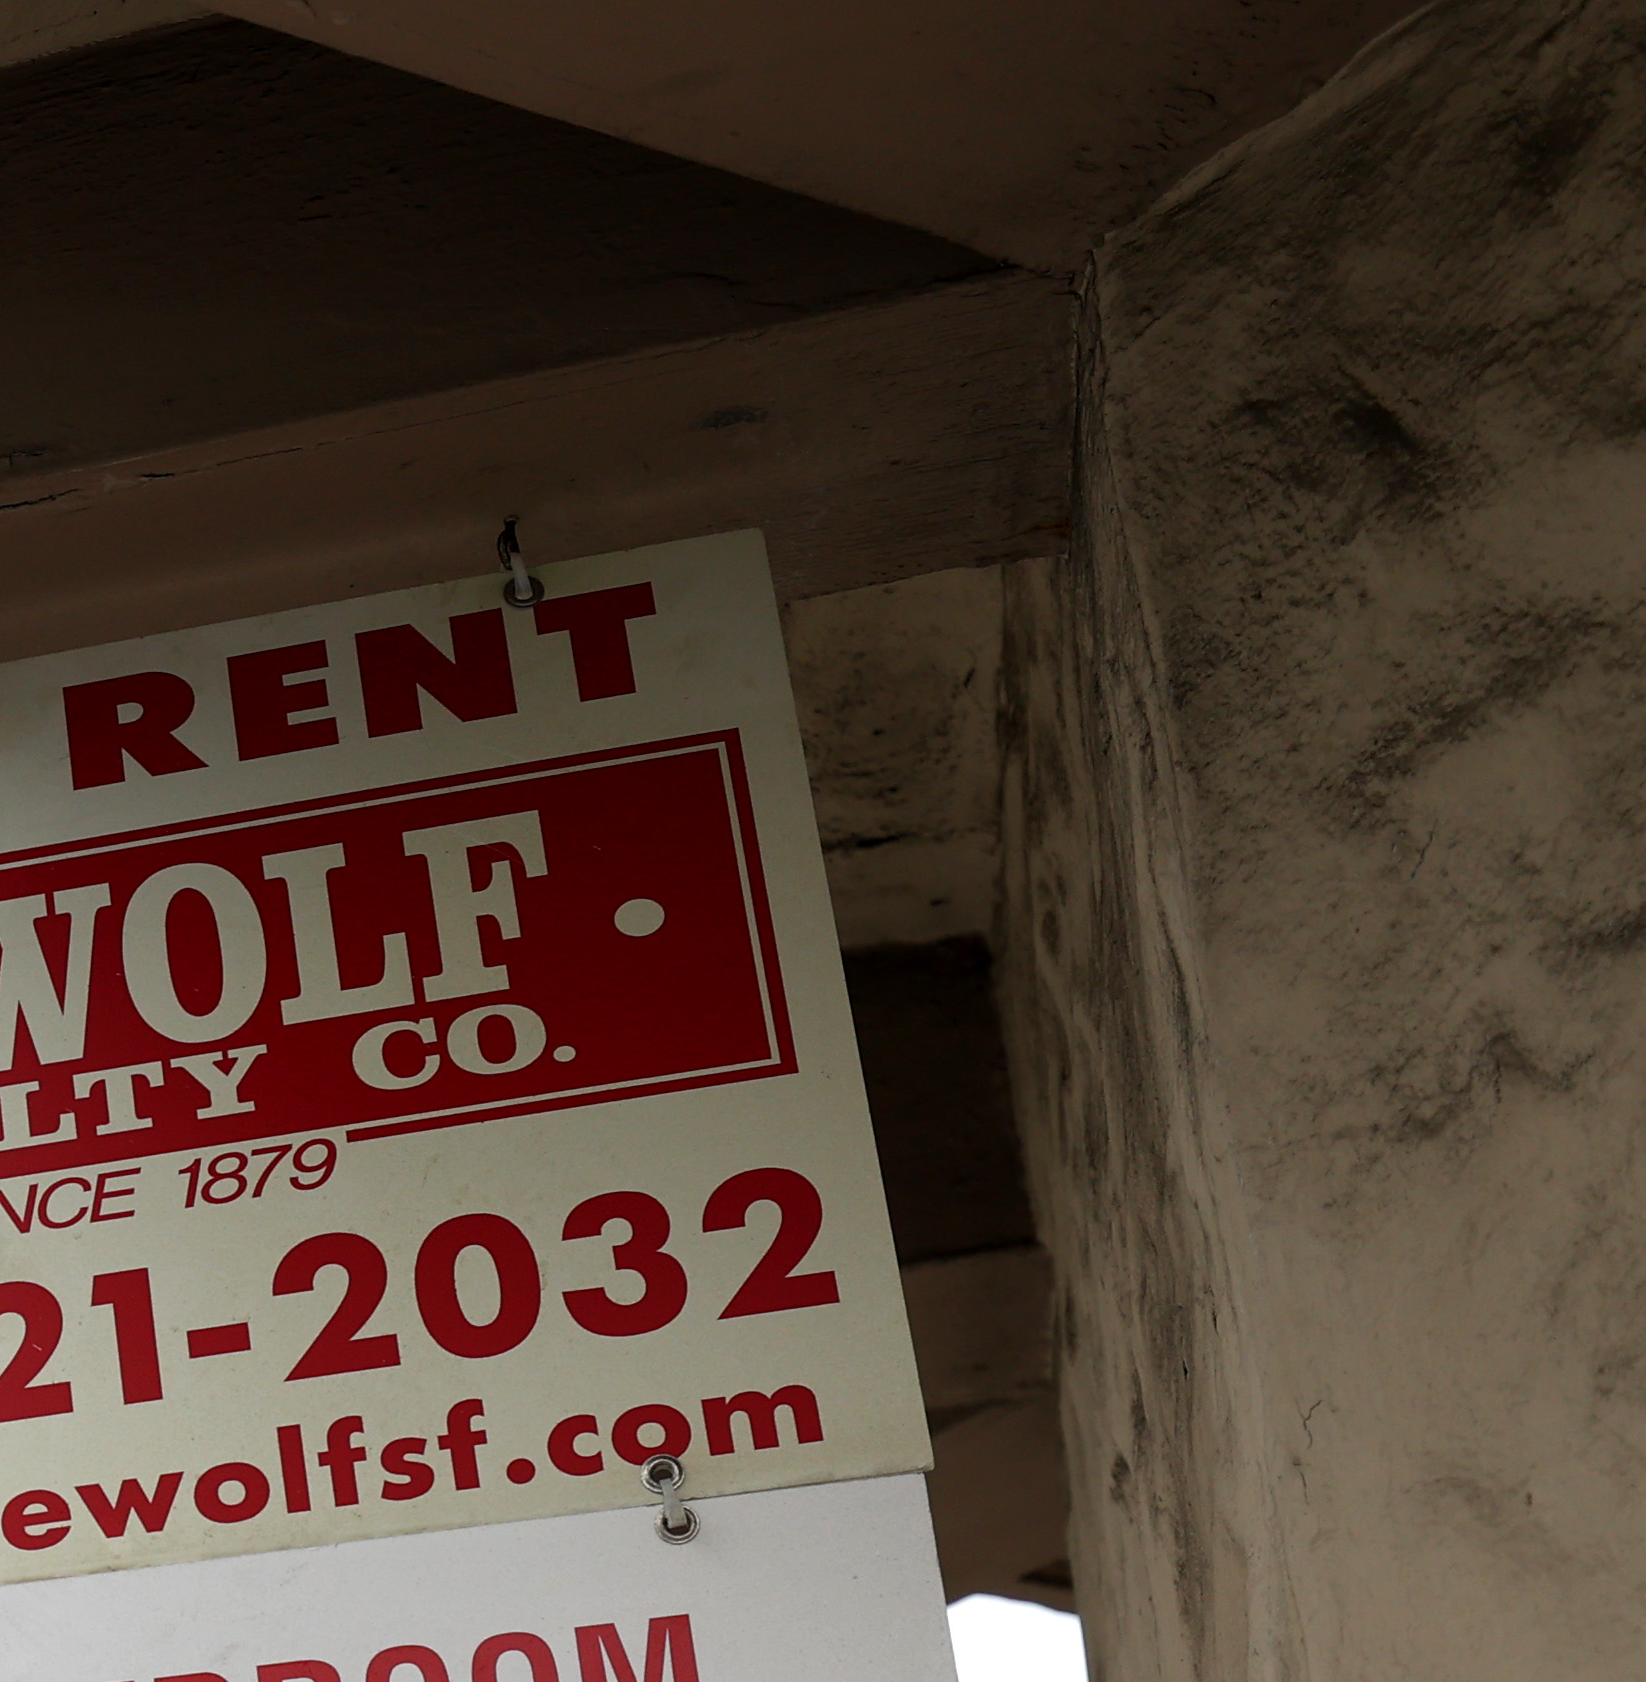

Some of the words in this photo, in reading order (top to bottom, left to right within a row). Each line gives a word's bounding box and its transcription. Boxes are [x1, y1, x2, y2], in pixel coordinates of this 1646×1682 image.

[62, 582, 657, 790] RENT
[350, 1003, 577, 1093] CO.
[174, 1137, 340, 1211] 1879
